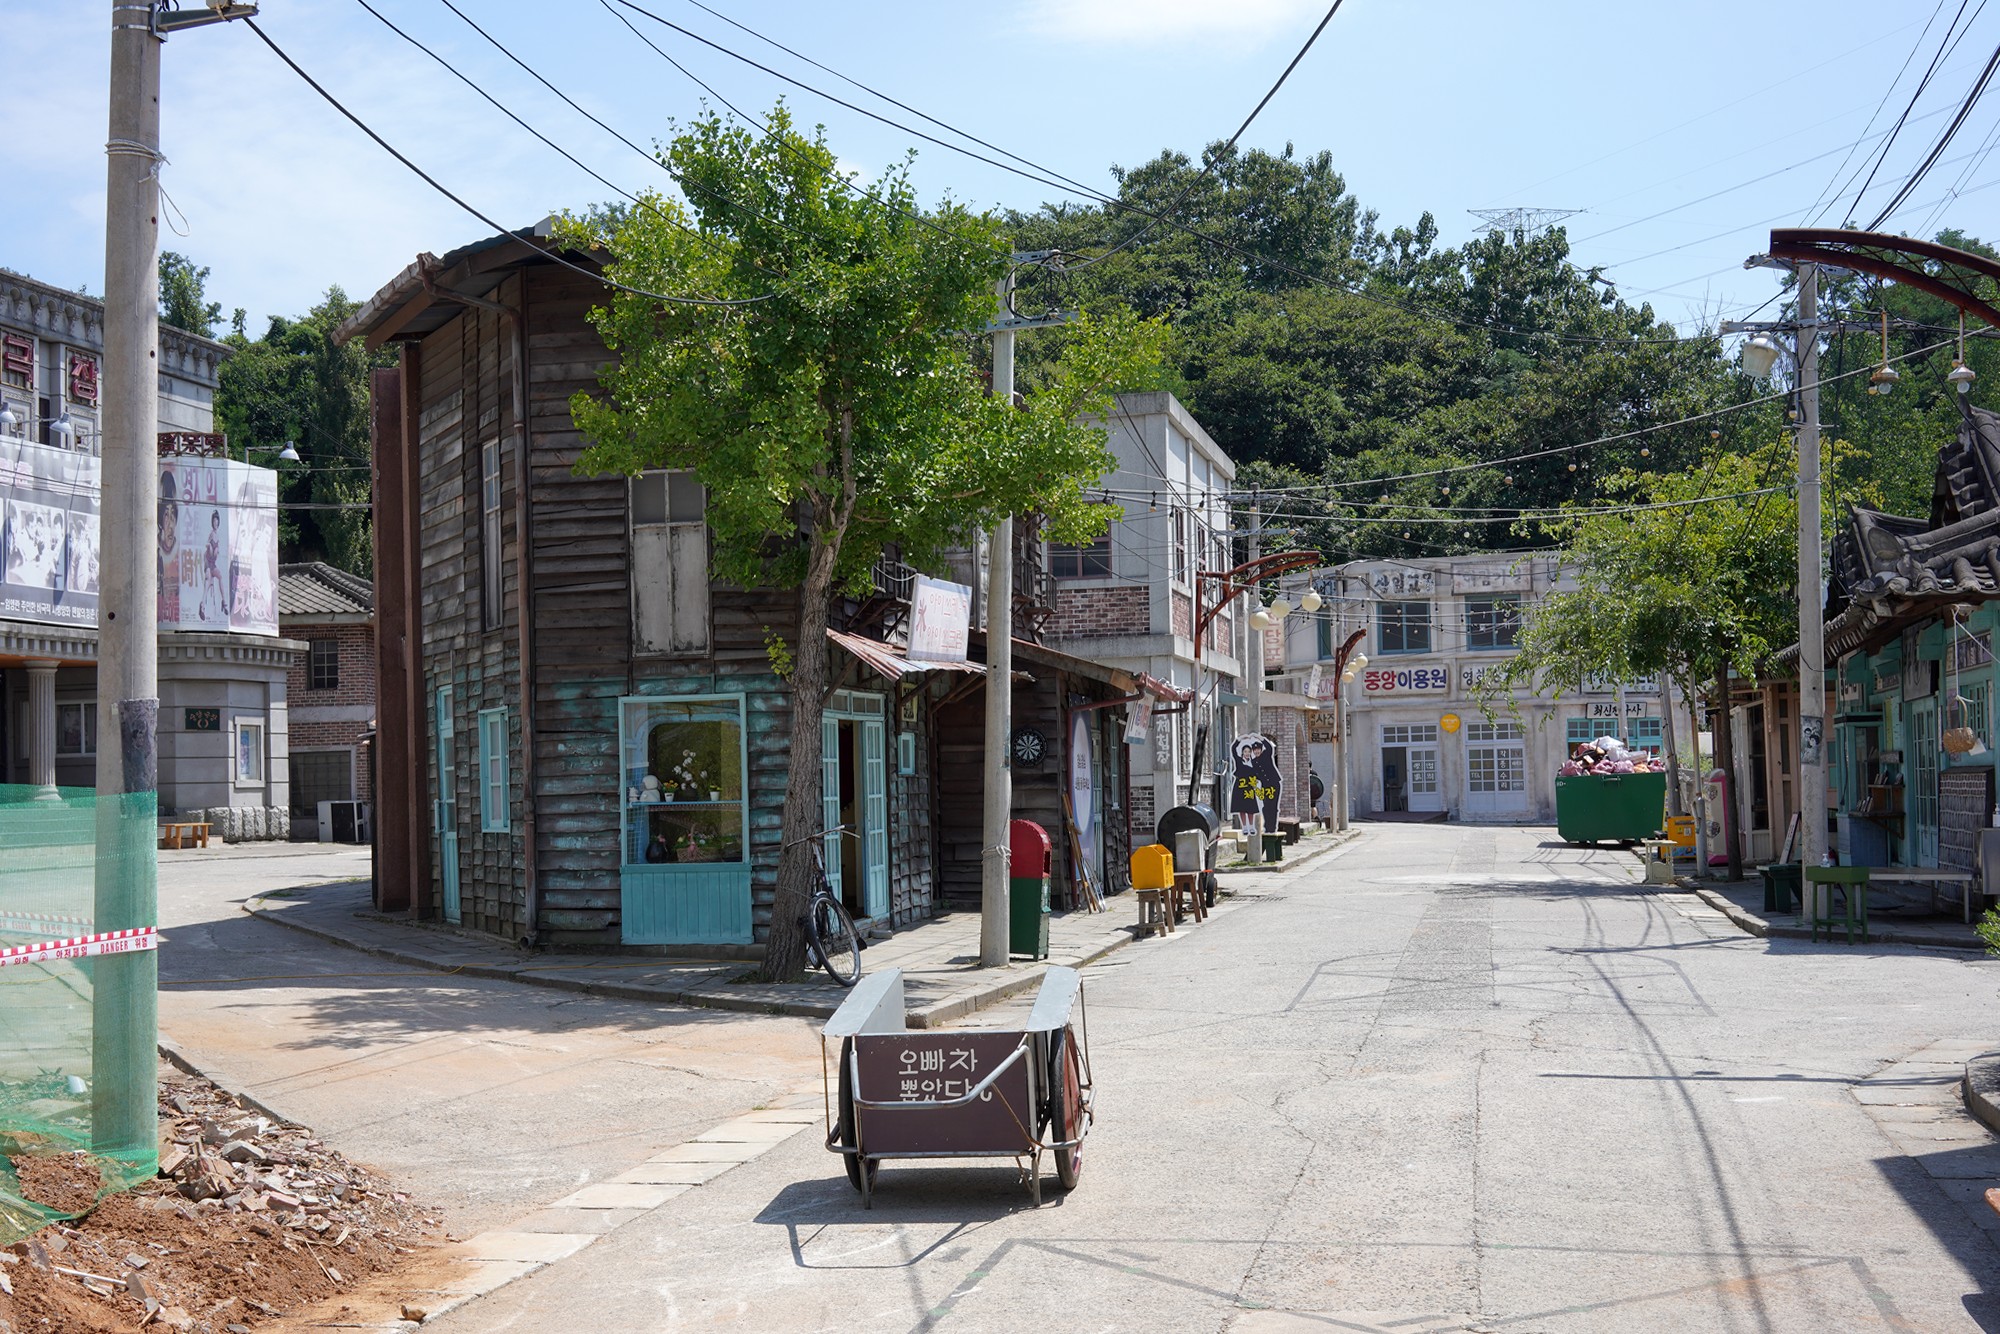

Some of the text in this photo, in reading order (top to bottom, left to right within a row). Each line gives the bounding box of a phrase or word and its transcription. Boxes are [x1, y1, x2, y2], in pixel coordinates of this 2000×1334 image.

[1364, 669, 1447, 691] 중앙이용원
[1238, 775, 1257, 788] 교복
[1244, 786, 1276, 800] 체험장
[100, 940, 129, 954] DANGER
[898, 1048, 978, 1075] 오빠차
